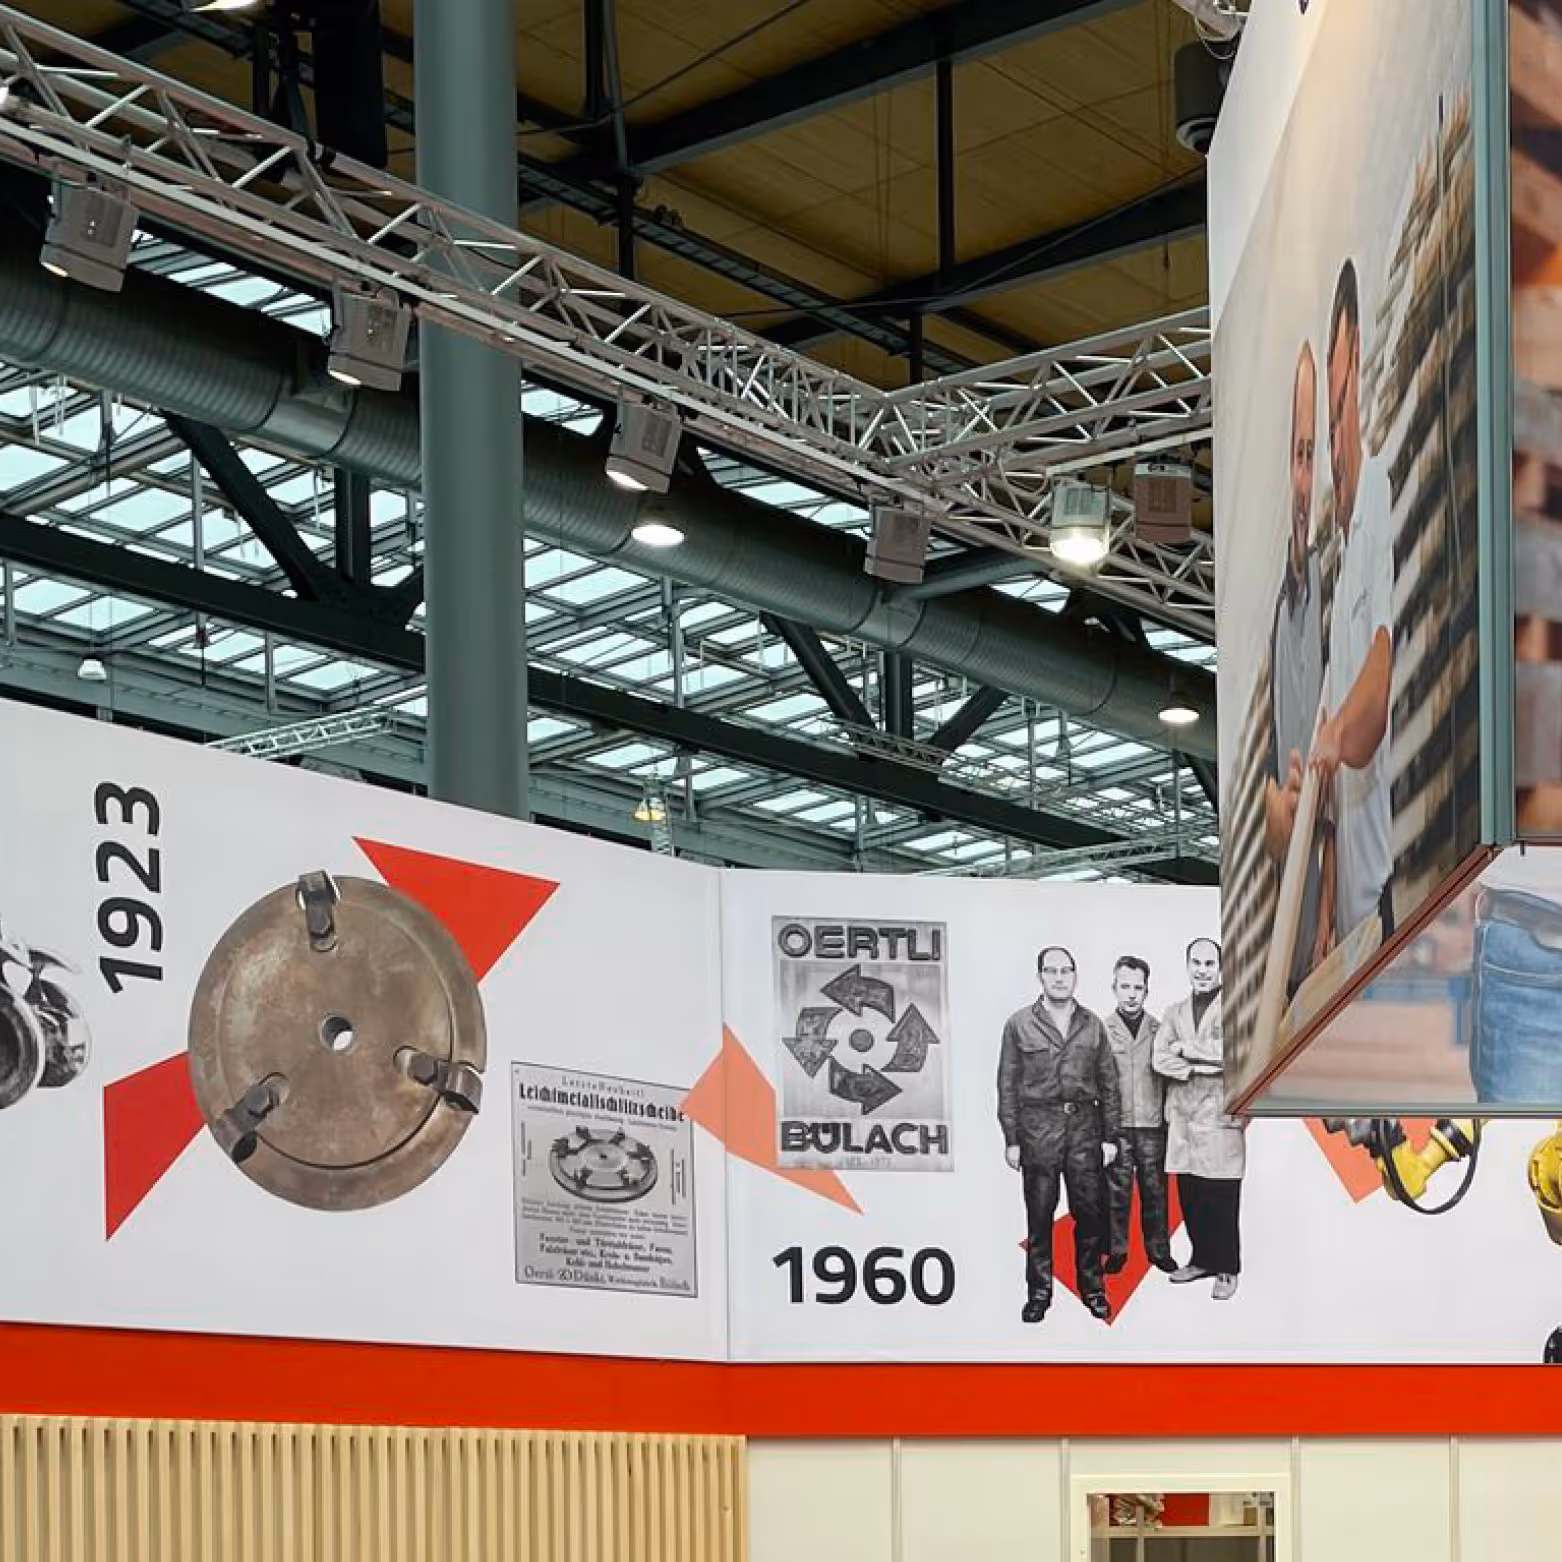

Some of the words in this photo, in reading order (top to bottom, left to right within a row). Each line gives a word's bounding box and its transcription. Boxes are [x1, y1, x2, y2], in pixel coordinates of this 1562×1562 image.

[94, 782, 163, 994] 1923
[778, 923, 941, 961] OERTLI
[781, 1120, 949, 1155] BÜLACH
[772, 1246, 956, 1305] 1960
